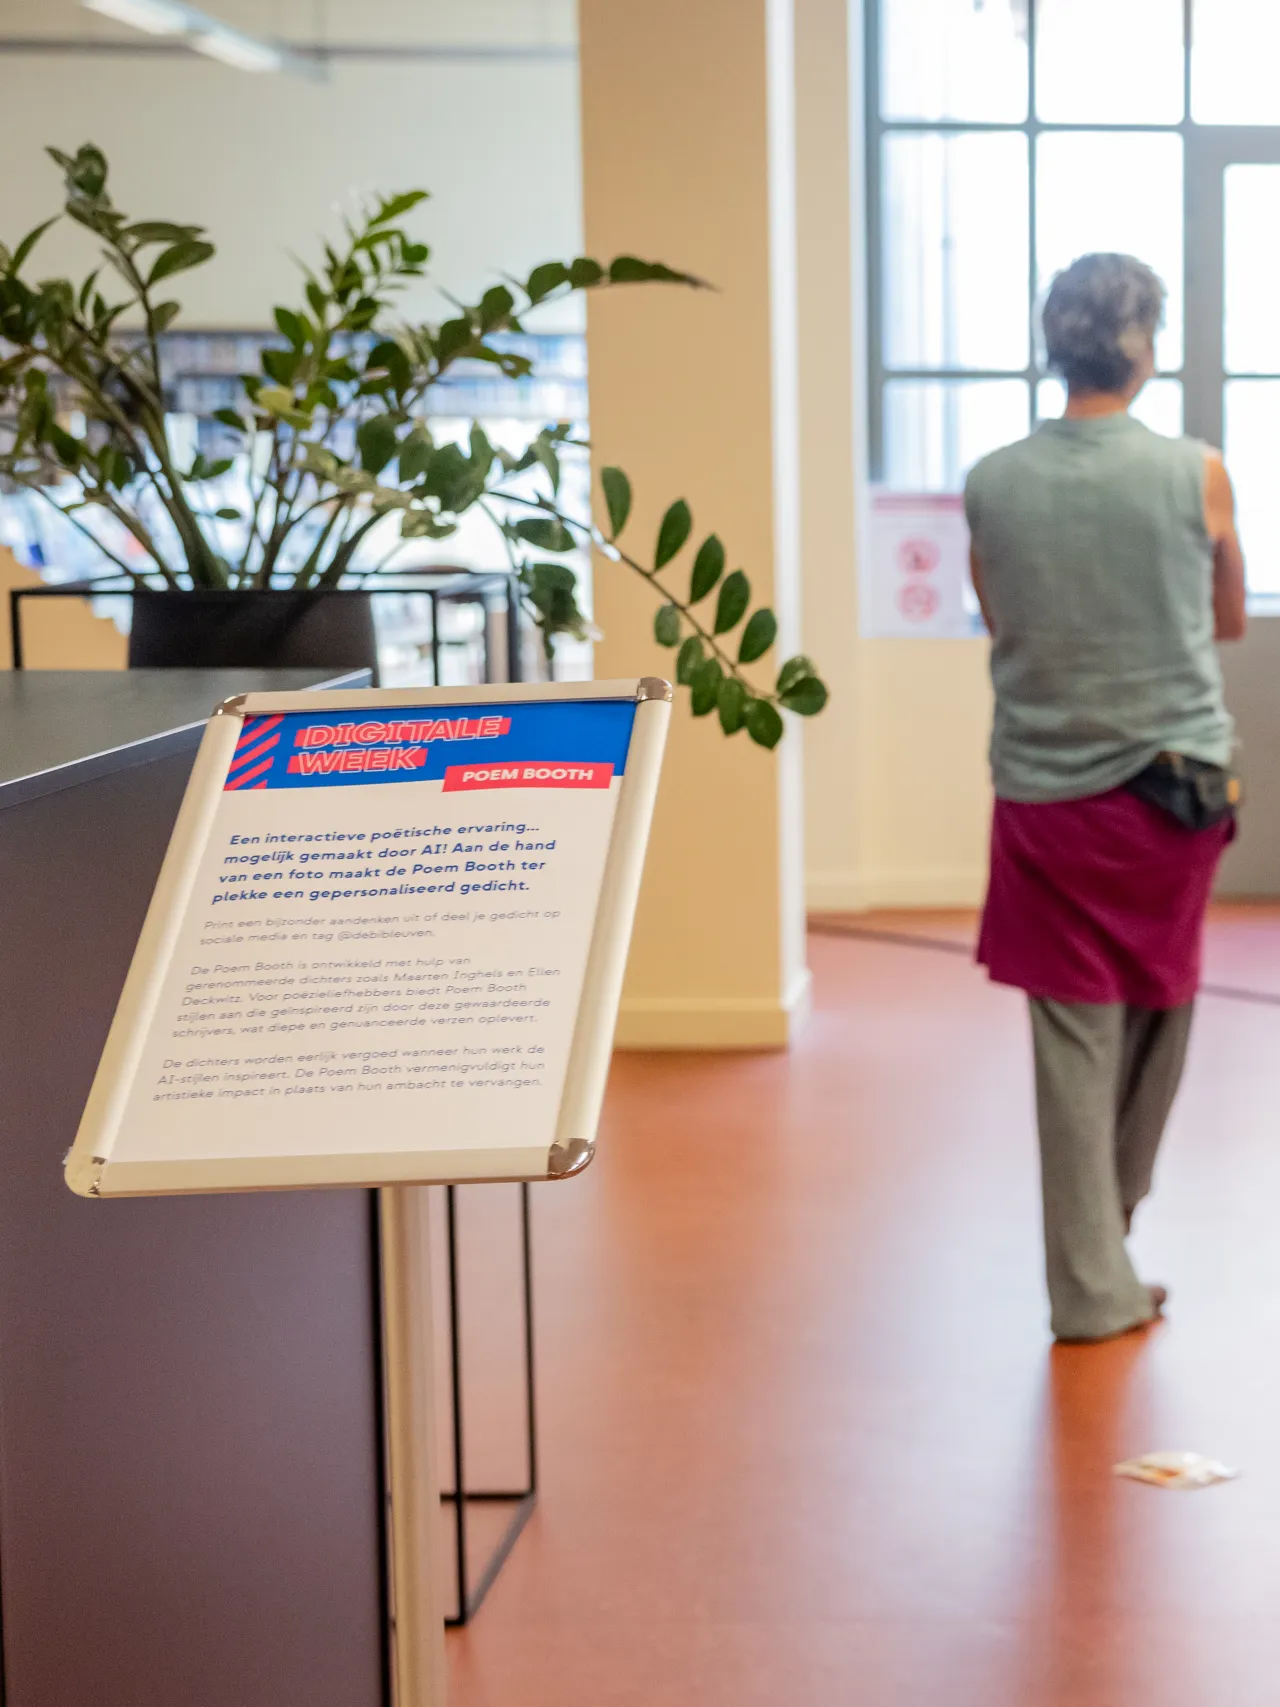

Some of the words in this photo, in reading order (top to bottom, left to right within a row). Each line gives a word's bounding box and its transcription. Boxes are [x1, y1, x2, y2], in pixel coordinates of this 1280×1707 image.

[303, 715, 503, 749] DIGITALE
[299, 746, 421, 776] WEEK
[462, 768, 519, 783] POEM
[522, 766, 594, 781] BOOTH
[229, 834, 260, 845] Een
[264, 831, 366, 844] interactieve
[370, 825, 453, 843] poëtische
[224, 850, 295, 866] mogelijk
[299, 849, 374, 864] gemaakt
[377, 847, 417, 858] door
[420, 843, 448, 855] AI!
[451, 842, 484, 853] Aan
[488, 840, 510, 852] de
[514, 839, 556, 851] hand
[219, 874, 248, 883] van
[252, 872, 284, 881] een
[288, 869, 324, 880] foto
[328, 867, 381, 879] maakt
[385, 865, 407, 877] de
[411, 863, 459, 875] Poem
[464, 860, 516, 872] Booth
[520, 861, 546, 870] ter
[211, 889, 268, 905] plekke
[272, 890, 304, 899] een
[309, 881, 456, 901] gepersonaliseerd
[460, 879, 530, 896] gedicht.
[203, 920, 235, 930] Print
[237, 920, 262, 928] een
[265, 916, 326, 928] bijzonder
[328, 915, 400, 926] aandenken
[402, 913, 421, 923] uit
[423, 912, 438, 922] of
[440, 912, 470, 921] deel
[472, 912, 486, 923] je
[489, 910, 540, 923] gedicht
[543, 910, 561, 919] op
[199, 934, 245, 945] sociale
[247, 932, 288, 942] media
[312, 933, 334, 942] tag
[337, 930, 435, 941] @debibleuven.
[190, 966, 210, 976] De
[213, 964, 251, 974] Poem
[254, 961, 294, 972] Booth
[297, 960, 308, 970] is
[311, 959, 383, 969] ontwikkeld
[415, 957, 445, 968] hulp
[185, 976, 296, 993] gerenommeerde
[298, 975, 353, 985] dichters
[355, 974, 389, 983] zoals
[392, 973, 449, 982] Maarten
[452, 969, 503, 982] Inghels
[527, 967, 560, 978] Ellen
[180, 995, 243, 1007] Deckwitz.
[248, 992, 280, 1002] Voor
[405, 987, 442, 996] biedt
[444, 985, 483, 994] Poem
[486, 983, 527, 993] Booth
[176, 1011, 216, 1024] stijlen
[218, 1011, 243, 1020] aan
[246, 1008, 267, 1018] die
[355, 1003, 379, 1015] zijn
[381, 1002, 415, 1012] door
[417, 1001, 451, 1011] deze
[453, 998, 551, 1012] gewaardeerde
[171, 1027, 236, 1039] schrijvers,
[240, 1025, 264, 1034] wat
[267, 1023, 306, 1033] diepe
[309, 1022, 326, 1030] en
[329, 1017, 427, 1031] genuanceerde
[430, 1017, 474, 1025] verzen
[478, 1014, 538, 1025] oplevert.
[162, 1059, 183, 1069] De
[185, 1058, 240, 1068] dichters
[244, 1054, 293, 1065] worden
[296, 1051, 338, 1063] eerlijk
[341, 1049, 399, 1062] vergoed
[401, 1048, 459, 1057] wanneer
[462, 1046, 488, 1055] hun
[491, 1045, 523, 1054] werk
[527, 1044, 545, 1054] de
[156, 1073, 220, 1086] AI-stijlen
[223, 1071, 290, 1083] inspireert.
[294, 1068, 315, 1078] De
[318, 1067, 357, 1077] Poem
[361, 1064, 402, 1075] Booth
[406, 1061, 516, 1074] vermenigvuldigt
[519, 1060, 545, 1070] hun
[152, 1089, 214, 1101] artistieke
[218, 1088, 266, 1099] impact
[268, 1086, 281, 1095] in
[284, 1085, 326, 1097] plaats
[330, 1084, 354, 1092] van
[356, 1081, 382, 1091] hun
[386, 1079, 447, 1090] ambacht
[450, 1080, 465, 1088] te
[468, 1079, 543, 1089] vervangen.
